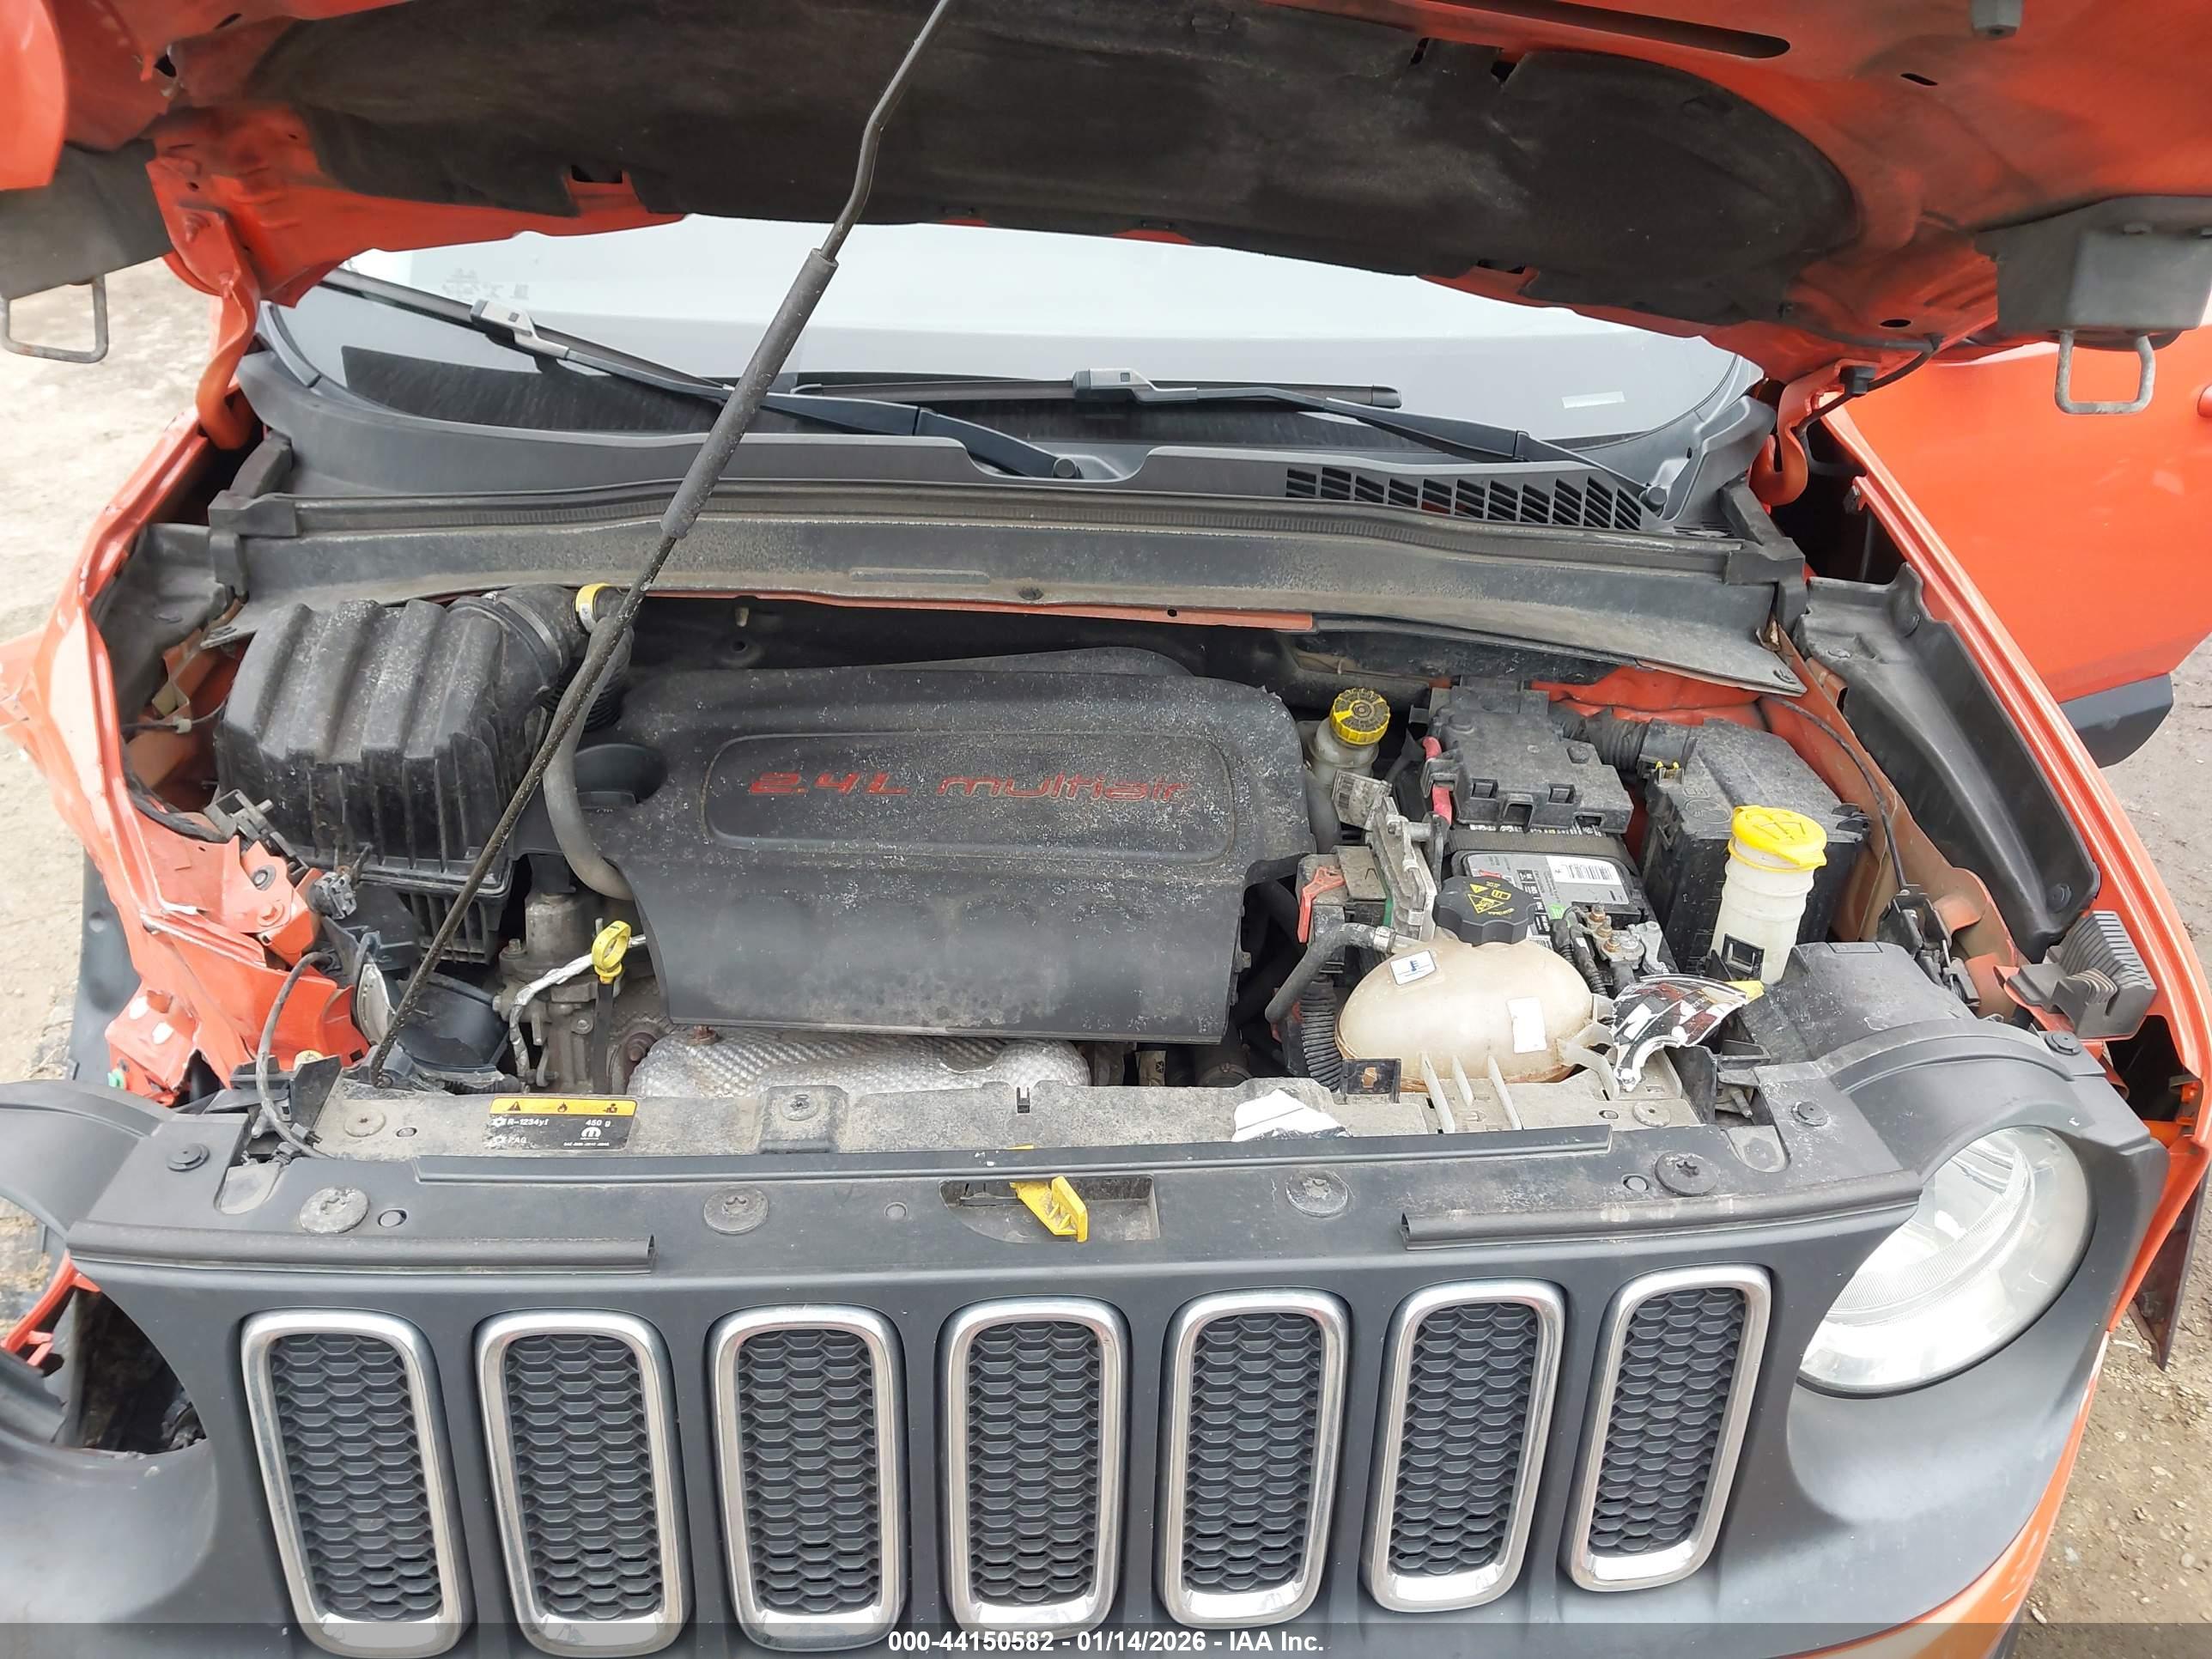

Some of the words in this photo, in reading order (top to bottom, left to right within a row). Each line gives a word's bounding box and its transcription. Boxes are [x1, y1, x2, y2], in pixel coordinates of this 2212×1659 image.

[748, 772, 908, 796] 2.4L
[936, 772, 1190, 801] multiair
[507, 1118, 549, 1127] R-1234yf
